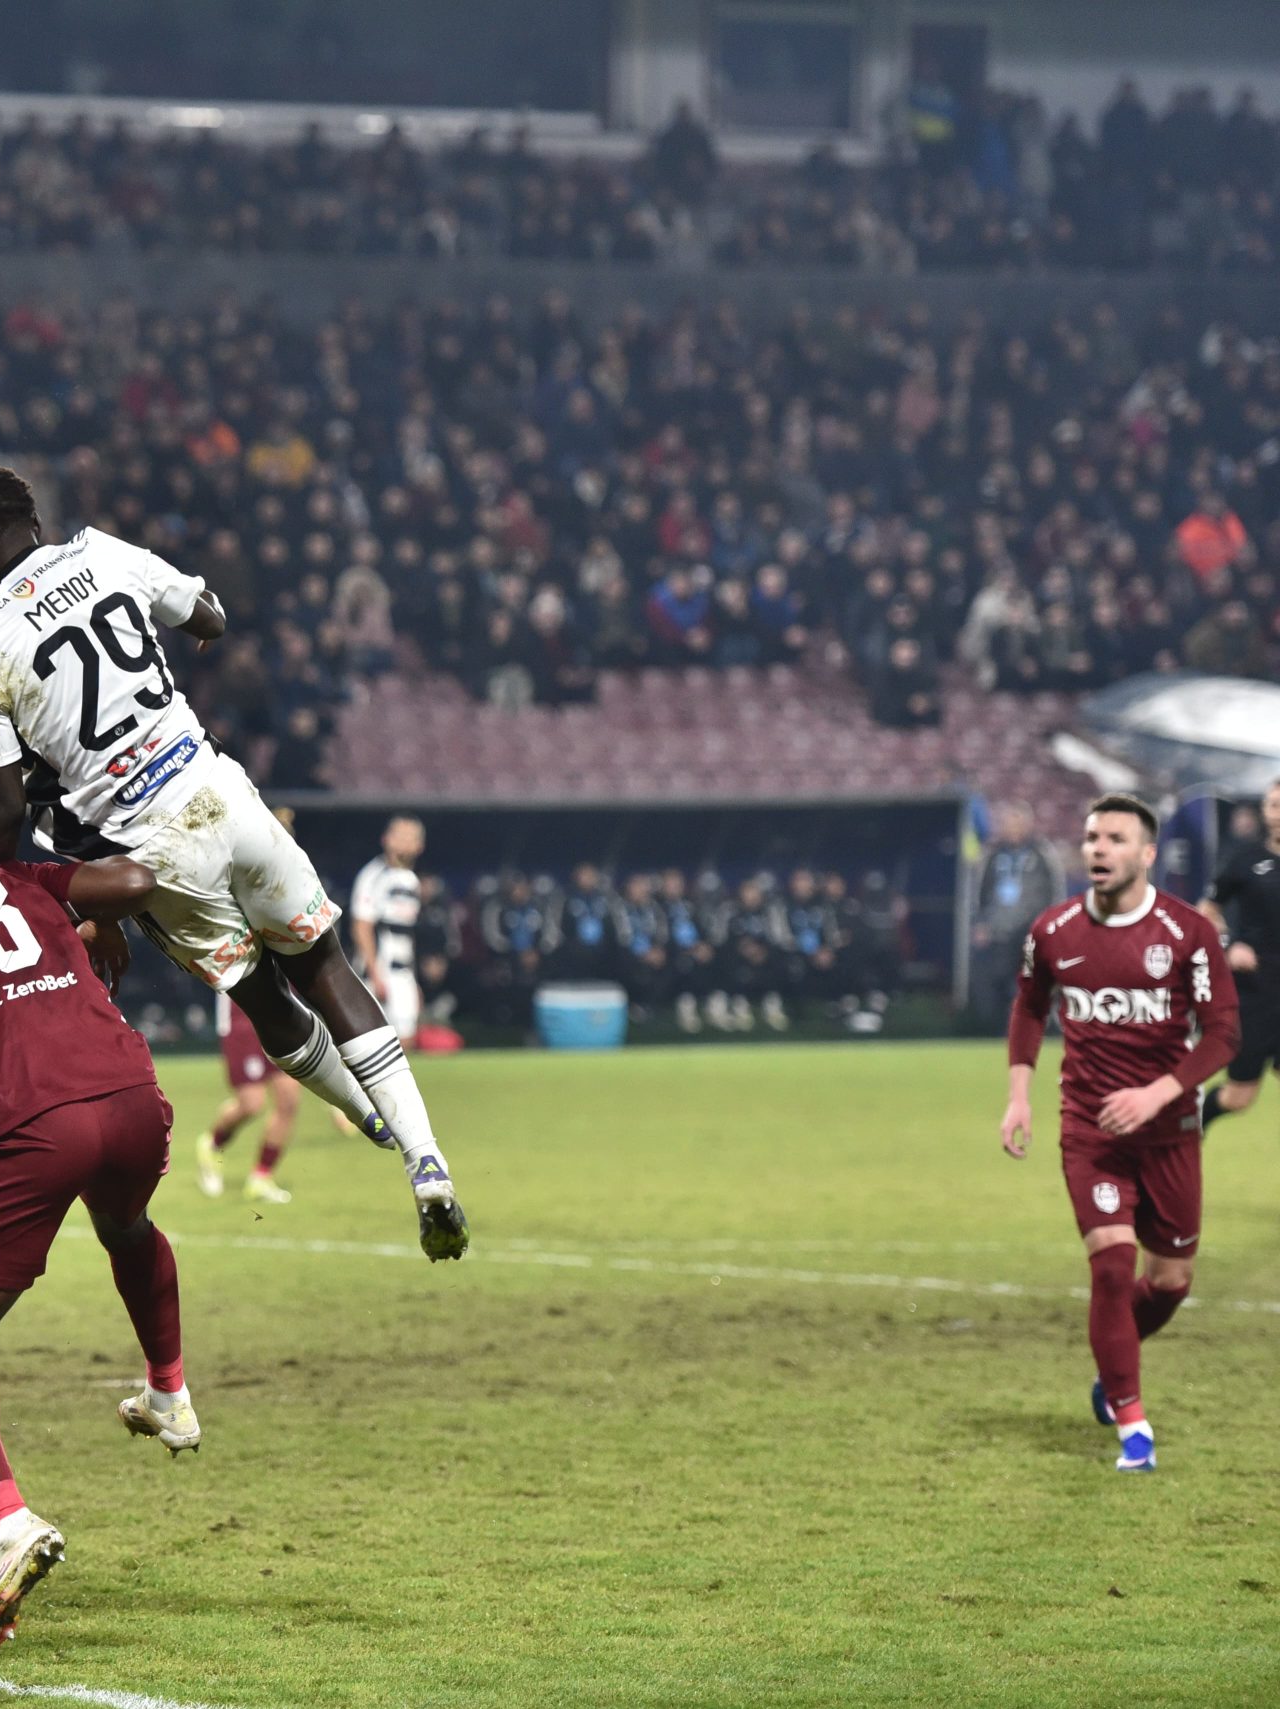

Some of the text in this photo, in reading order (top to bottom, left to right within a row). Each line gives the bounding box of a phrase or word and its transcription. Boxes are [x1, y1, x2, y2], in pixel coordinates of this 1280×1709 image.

[23, 567, 99, 632] MENDY
[32, 591, 174, 751] 29
[2, 971, 78, 1001] ZeroBet
